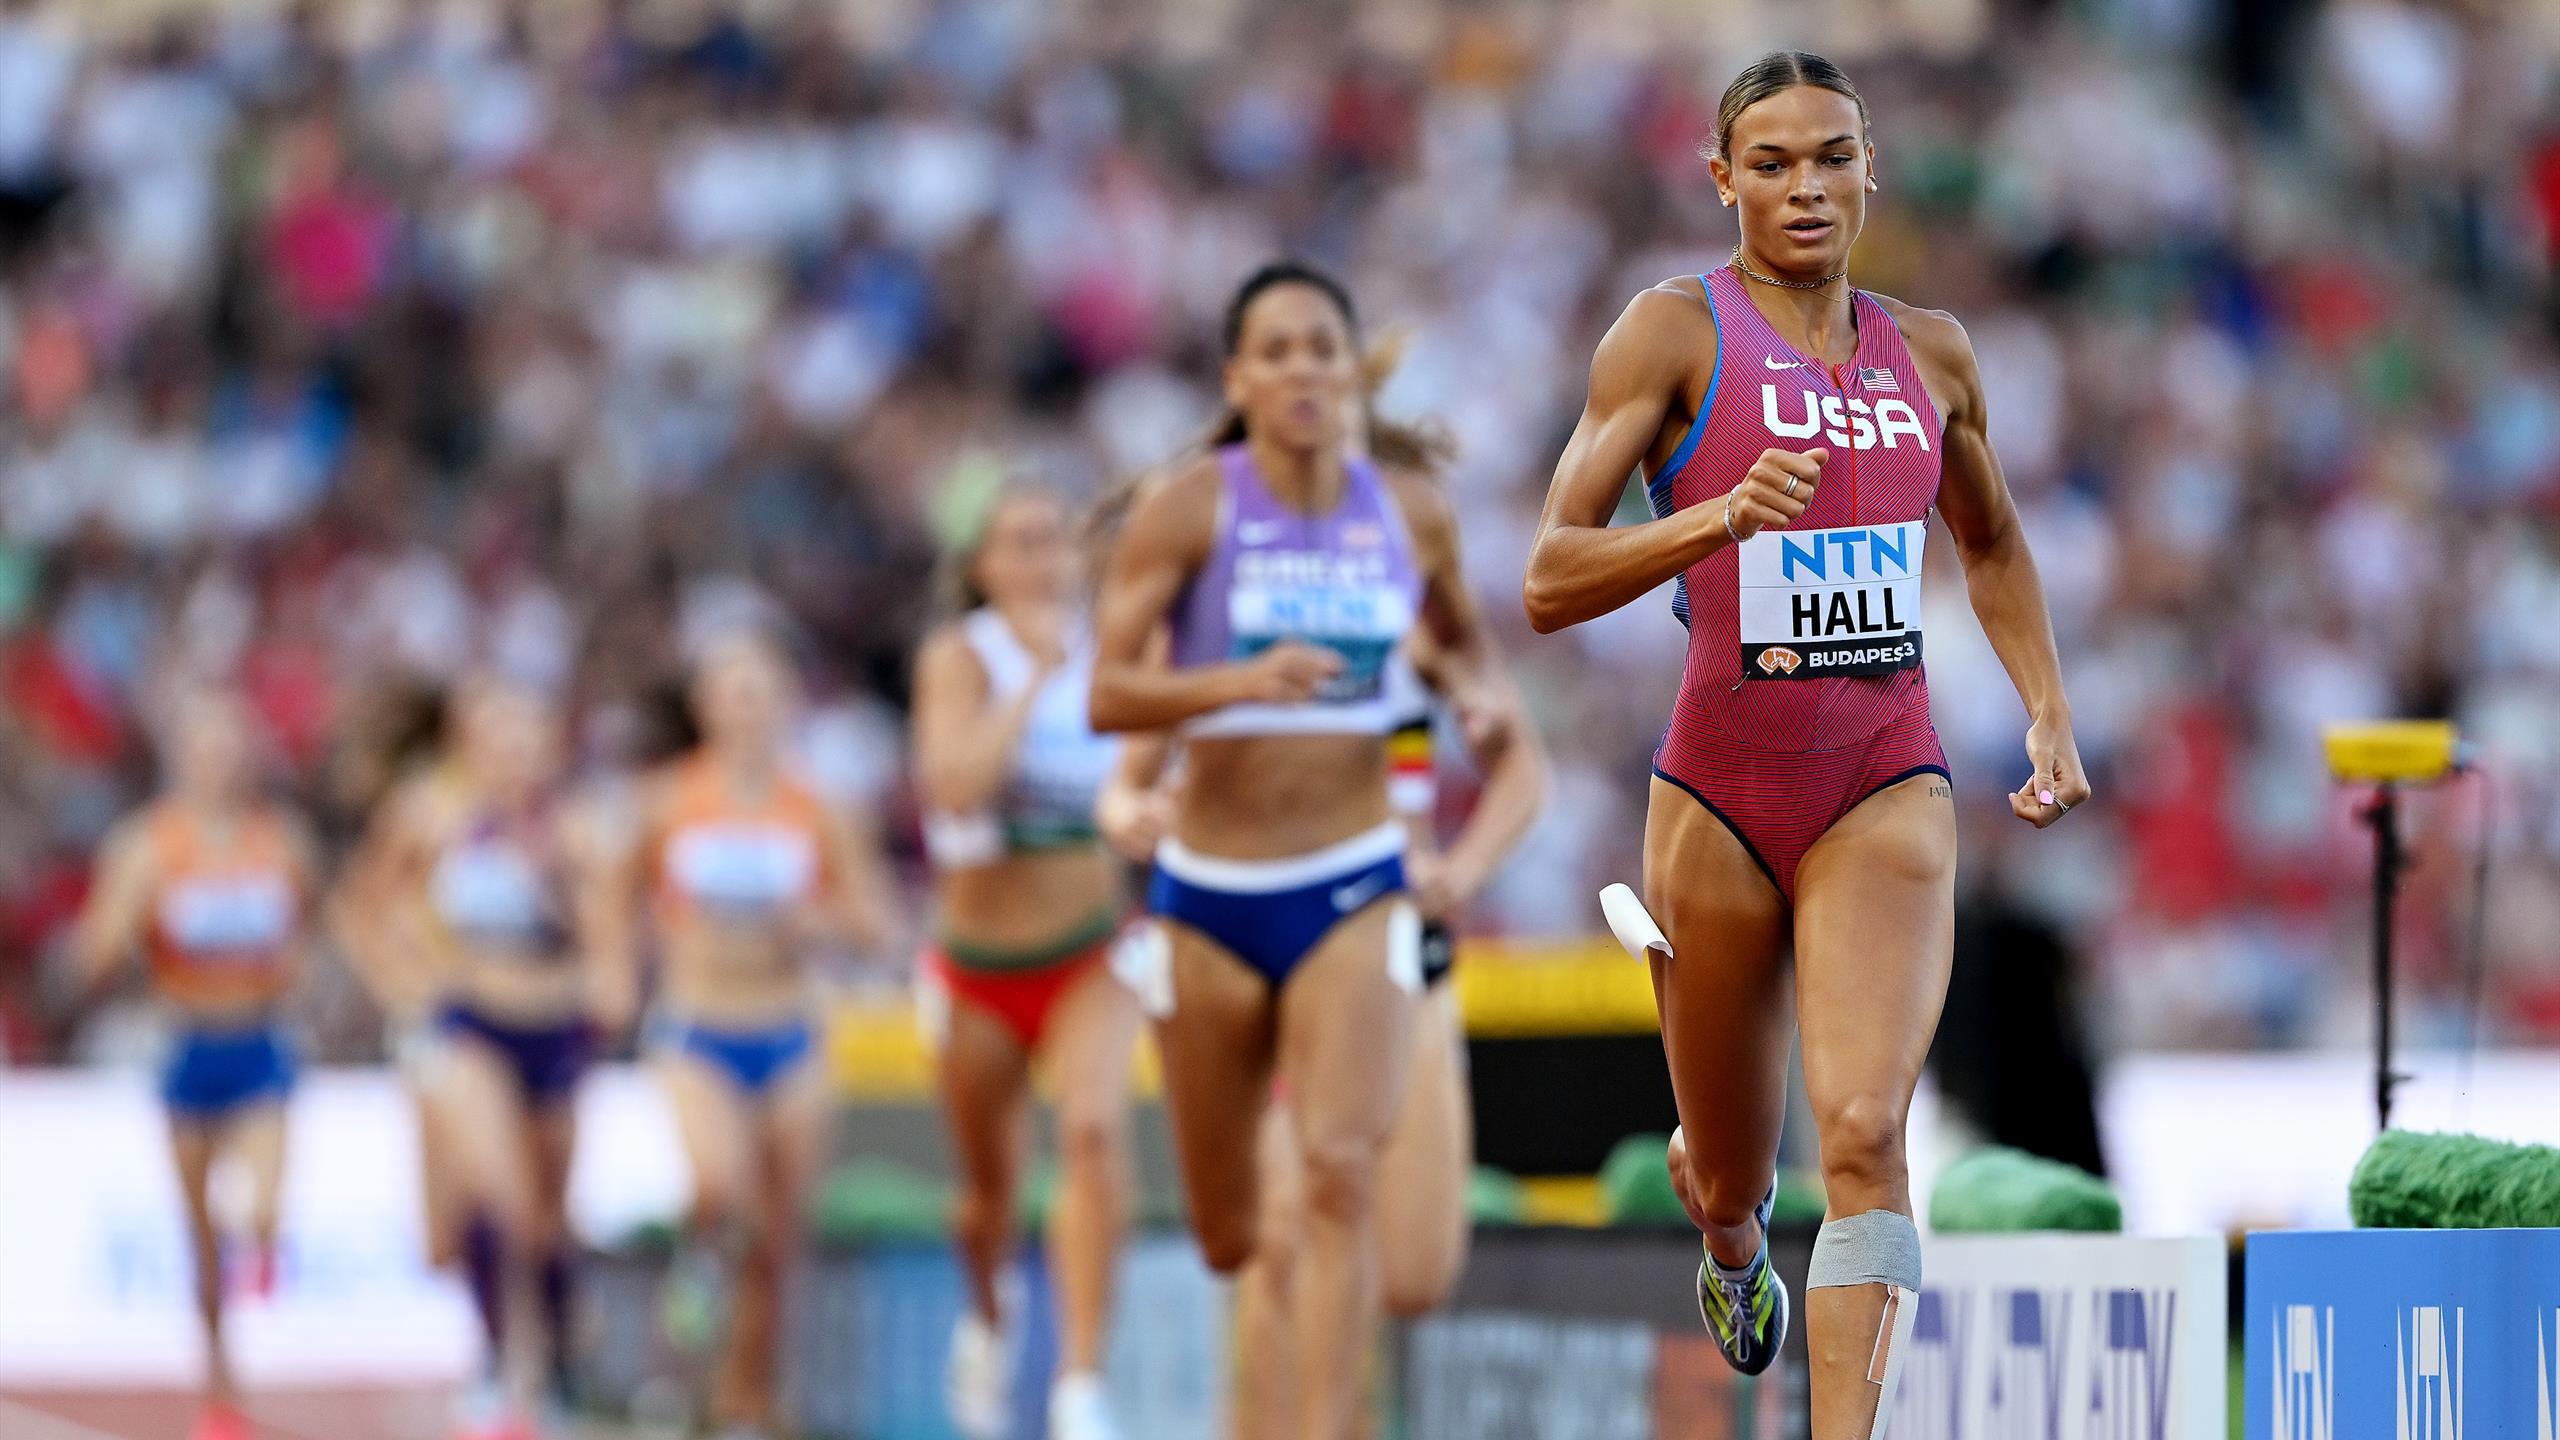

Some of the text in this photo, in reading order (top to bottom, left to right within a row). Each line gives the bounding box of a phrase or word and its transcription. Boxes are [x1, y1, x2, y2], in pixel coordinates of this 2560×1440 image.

[1762, 384, 1930, 452] USA
[1782, 526, 1908, 583] NTN
[1791, 587, 1905, 638] HALL
